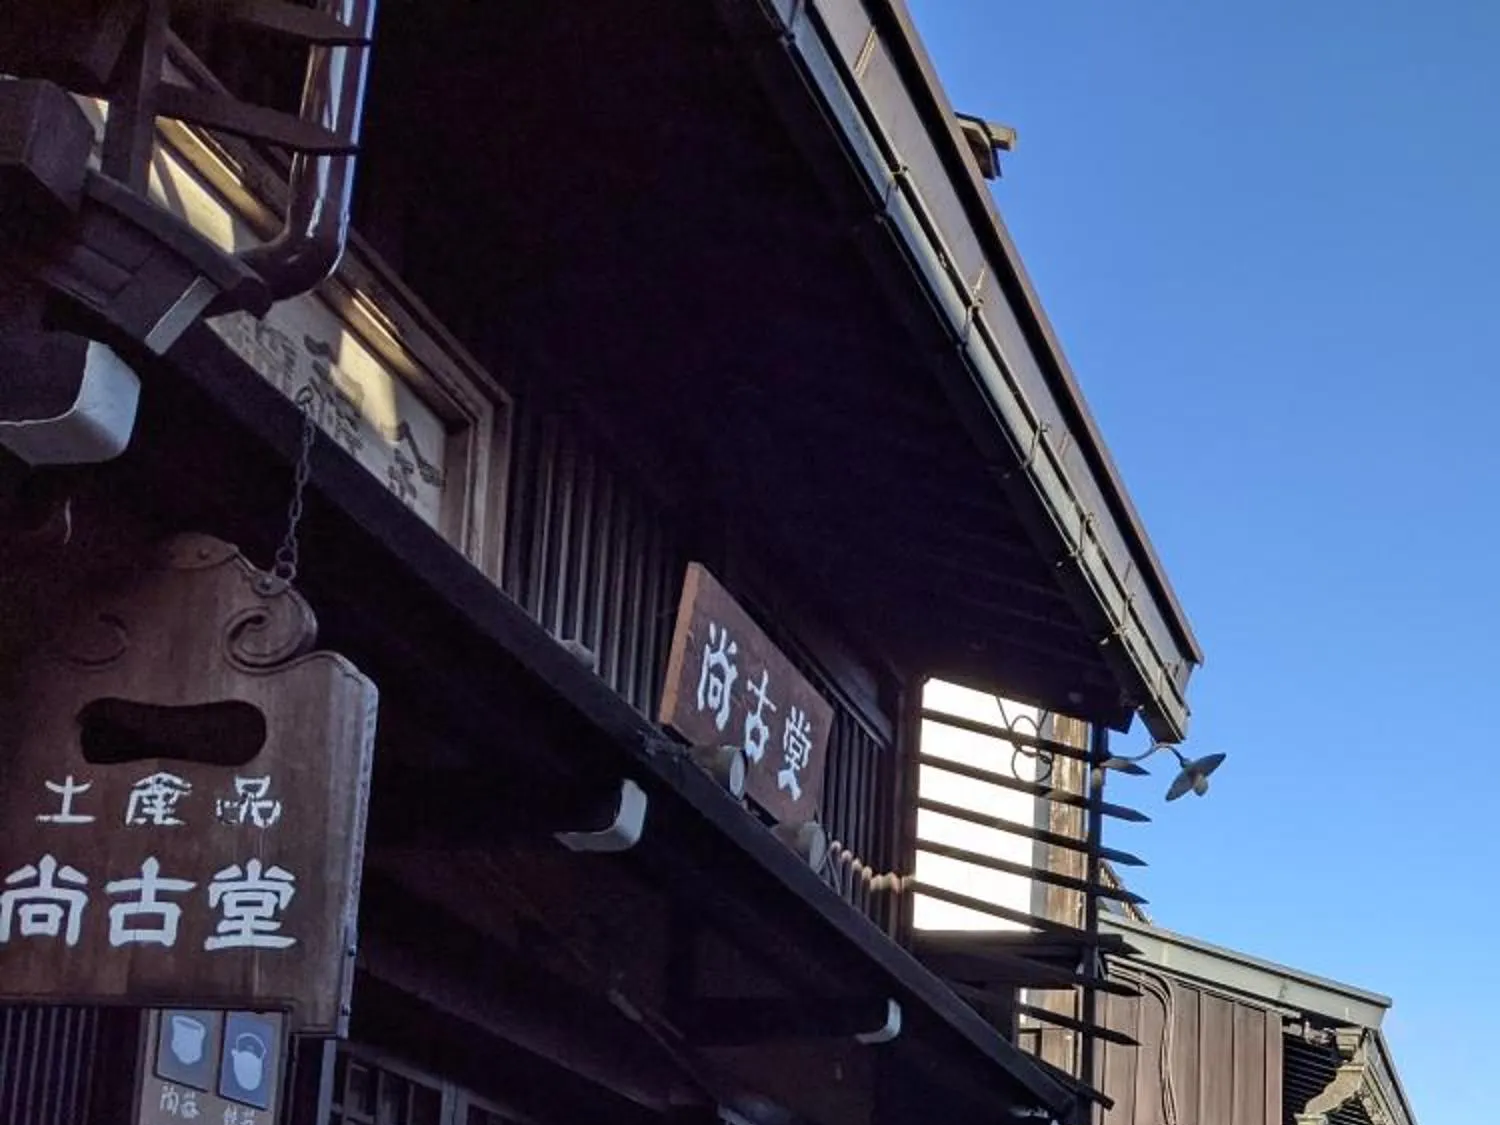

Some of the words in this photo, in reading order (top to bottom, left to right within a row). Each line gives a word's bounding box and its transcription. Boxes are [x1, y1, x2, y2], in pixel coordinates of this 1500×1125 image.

[698, 622, 812, 801] 尚古堂
[36, 772, 282, 829] 土産品
[0, 853, 297, 951] 尚古堂
